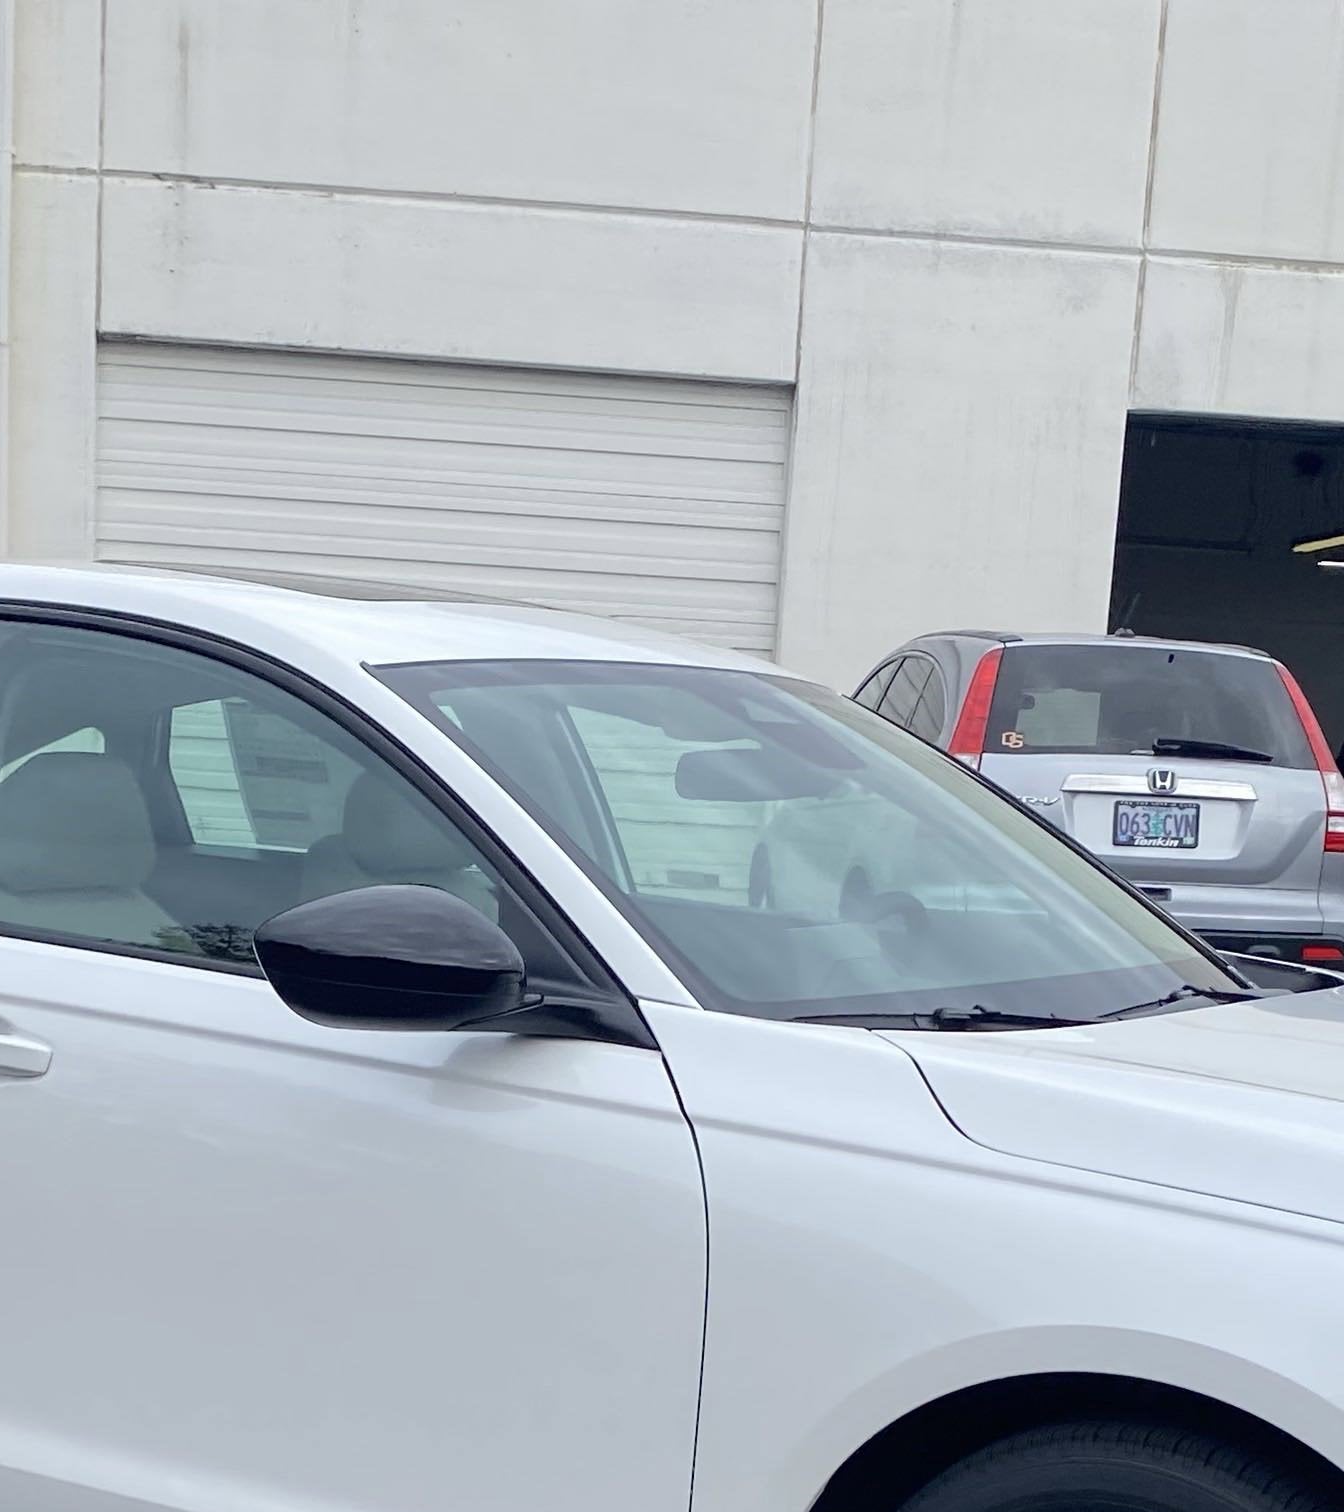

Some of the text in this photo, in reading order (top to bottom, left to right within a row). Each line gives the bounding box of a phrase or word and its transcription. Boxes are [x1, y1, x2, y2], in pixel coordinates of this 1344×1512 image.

[1119, 811, 1197, 838] 063 CVN
[1133, 836, 1180, 847] Tonkin
